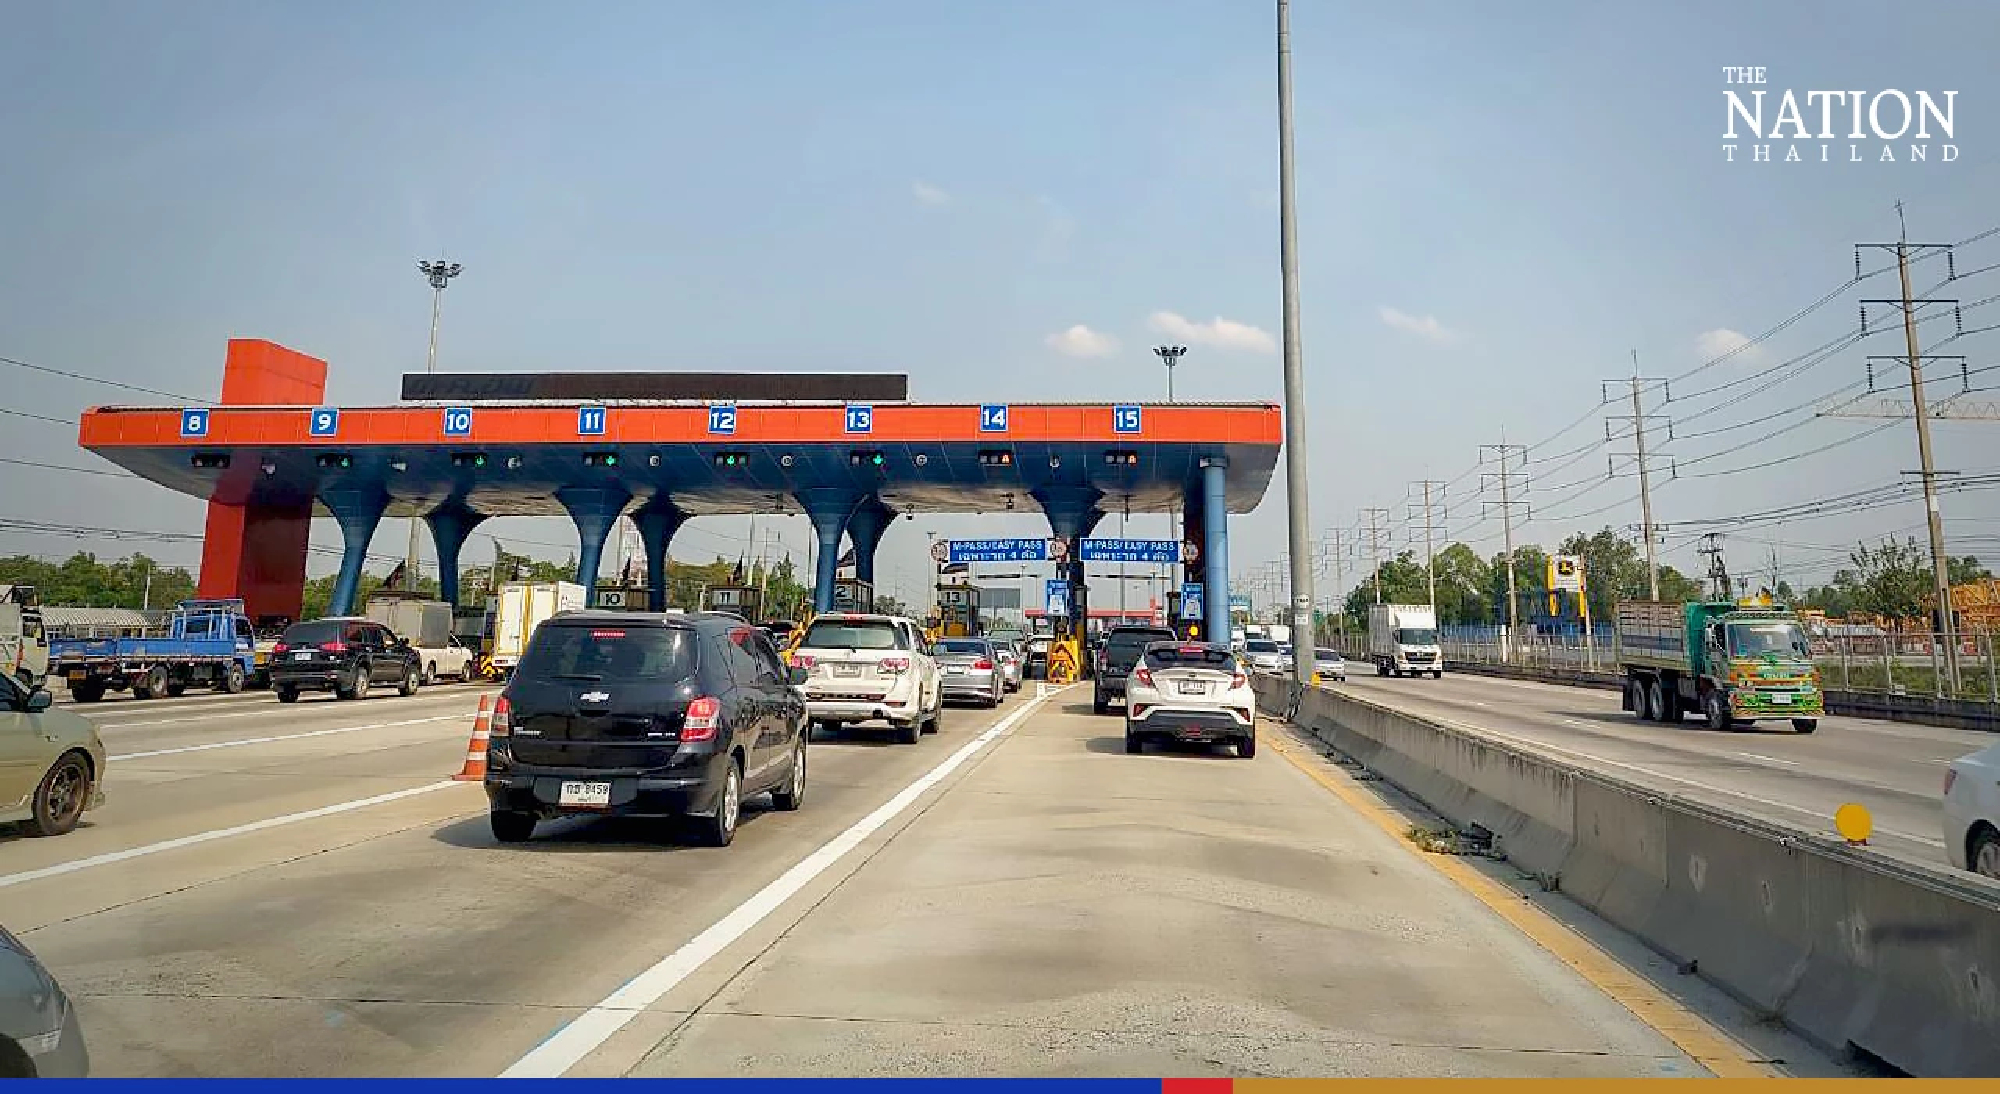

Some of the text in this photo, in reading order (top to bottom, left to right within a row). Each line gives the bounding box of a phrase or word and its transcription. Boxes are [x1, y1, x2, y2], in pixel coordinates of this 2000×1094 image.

[188, 415, 201, 431] 8
[318, 413, 332, 431] 9
[447, 413, 470, 431] 10
[585, 412, 600, 430] 11
[711, 412, 734, 429] 12
[848, 411, 870, 428] 13
[983, 408, 1006, 427] 14
[1117, 410, 1138, 428] 15
[1018, 540, 1043, 550] PASS
[1151, 541, 1175, 551] PASS
[605, 593, 621, 605] 10
